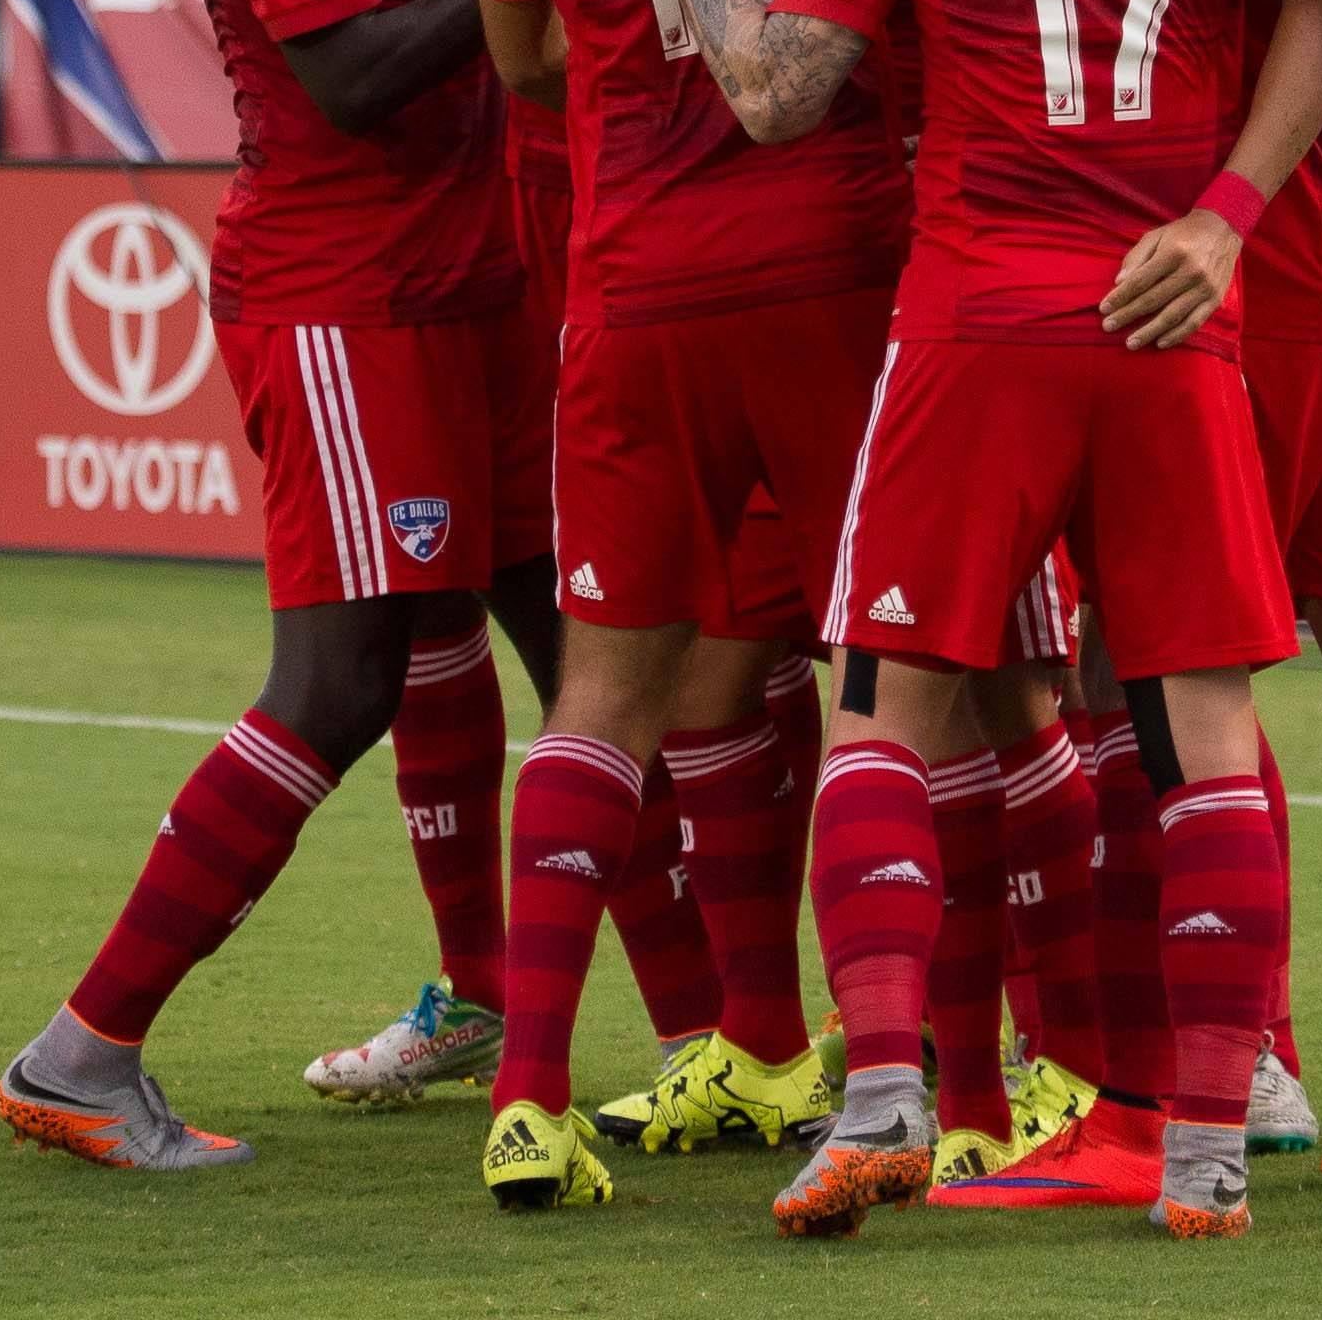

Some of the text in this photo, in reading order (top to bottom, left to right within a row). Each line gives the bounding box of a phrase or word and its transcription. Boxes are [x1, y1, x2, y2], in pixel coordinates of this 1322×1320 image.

[36, 434, 240, 516] TOYOTA
[393, 502, 445, 522] FC DALLAS
[569, 583, 604, 601] adidas
[868, 608, 915, 625] adidas
[398, 1024, 486, 1065] DIADORA
[487, 1145, 550, 1170] adidas
